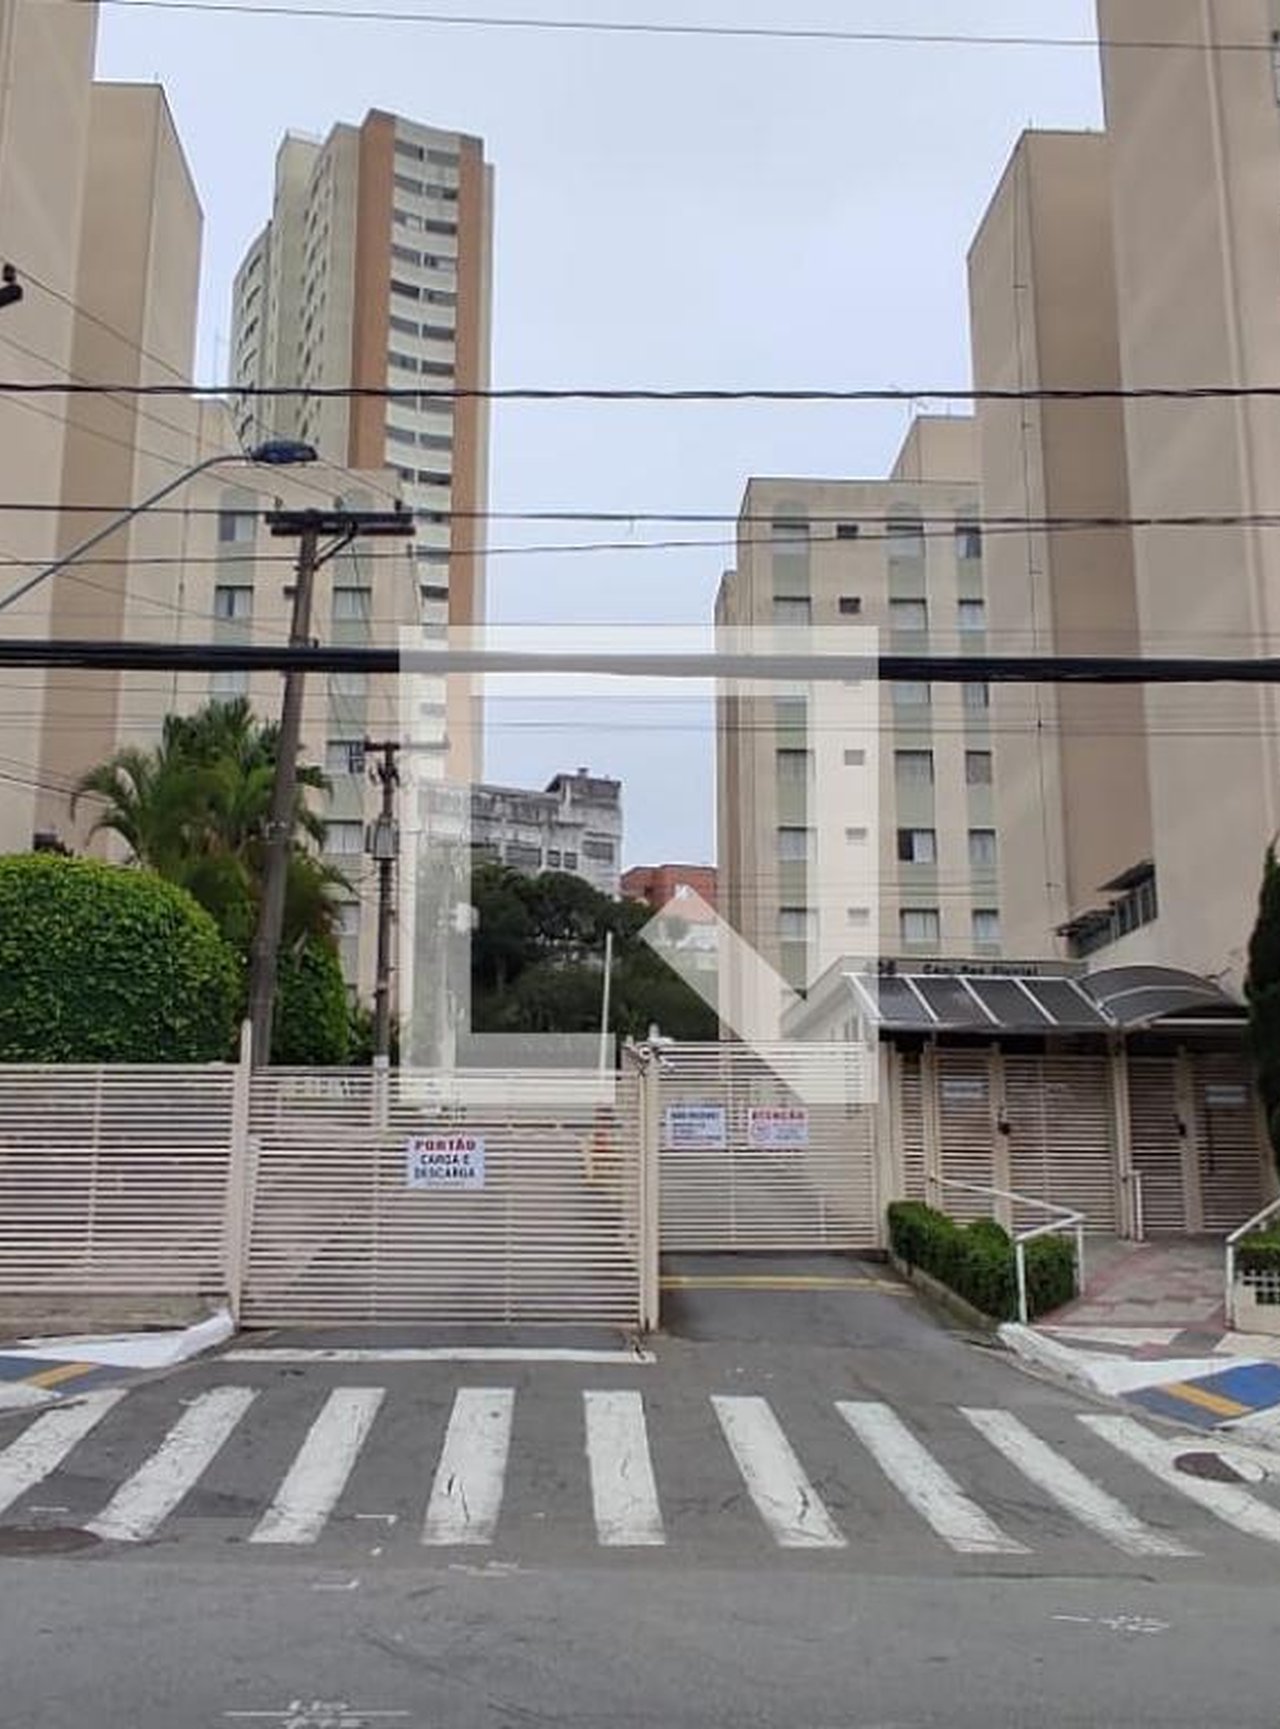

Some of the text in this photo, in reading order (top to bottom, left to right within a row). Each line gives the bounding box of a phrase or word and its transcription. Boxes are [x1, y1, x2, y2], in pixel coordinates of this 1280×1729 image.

[414, 1137, 476, 1151] PORTÃO
[421, 1154, 471, 1165] CARGA E
[414, 1167, 476, 1179] DESCARGA
